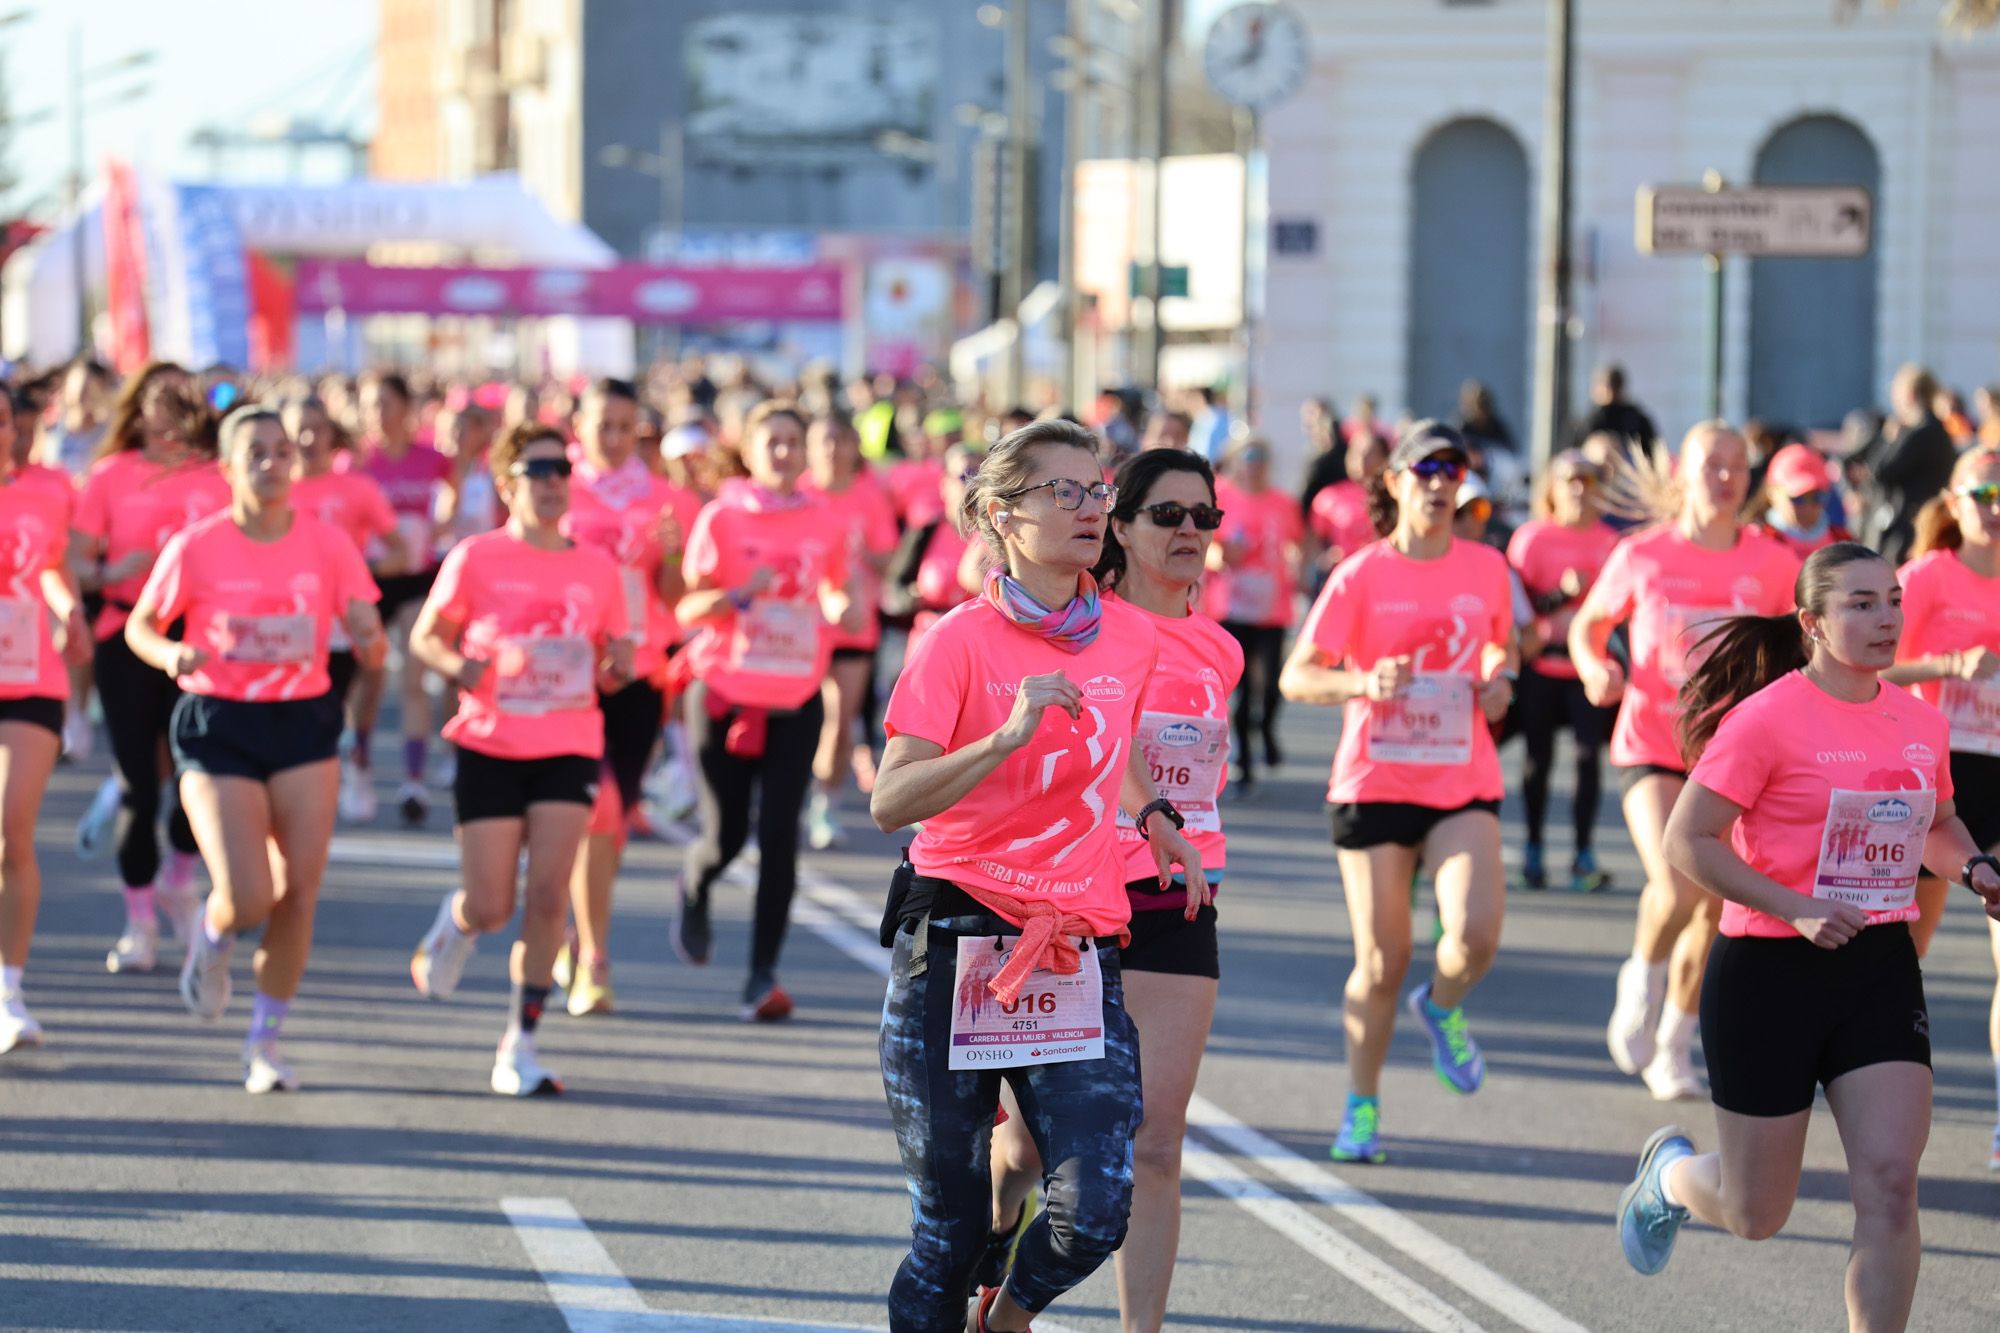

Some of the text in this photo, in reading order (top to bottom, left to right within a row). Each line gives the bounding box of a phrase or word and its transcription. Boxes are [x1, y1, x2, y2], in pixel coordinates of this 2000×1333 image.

[1816, 750, 1866, 764] OYSHO
[1151, 764, 1190, 785] 016
[1864, 843, 1905, 862] 016
[1016, 872, 1035, 887] DE
[1035, 878, 1051, 892] LA
[1828, 890, 1870, 903] OYSHO
[1002, 992, 1056, 1015] 016
[1012, 1020, 1038, 1030] 4751
[969, 1035, 999, 1043] CARRERA
[1012, 1034, 1020, 1042] LA
[1022, 1033, 1046, 1041] MUJER
[1052, 1031, 1084, 1039] VALENCIA
[966, 1049, 1013, 1061] OYSHO
[1042, 1045, 1087, 1056] Santander
